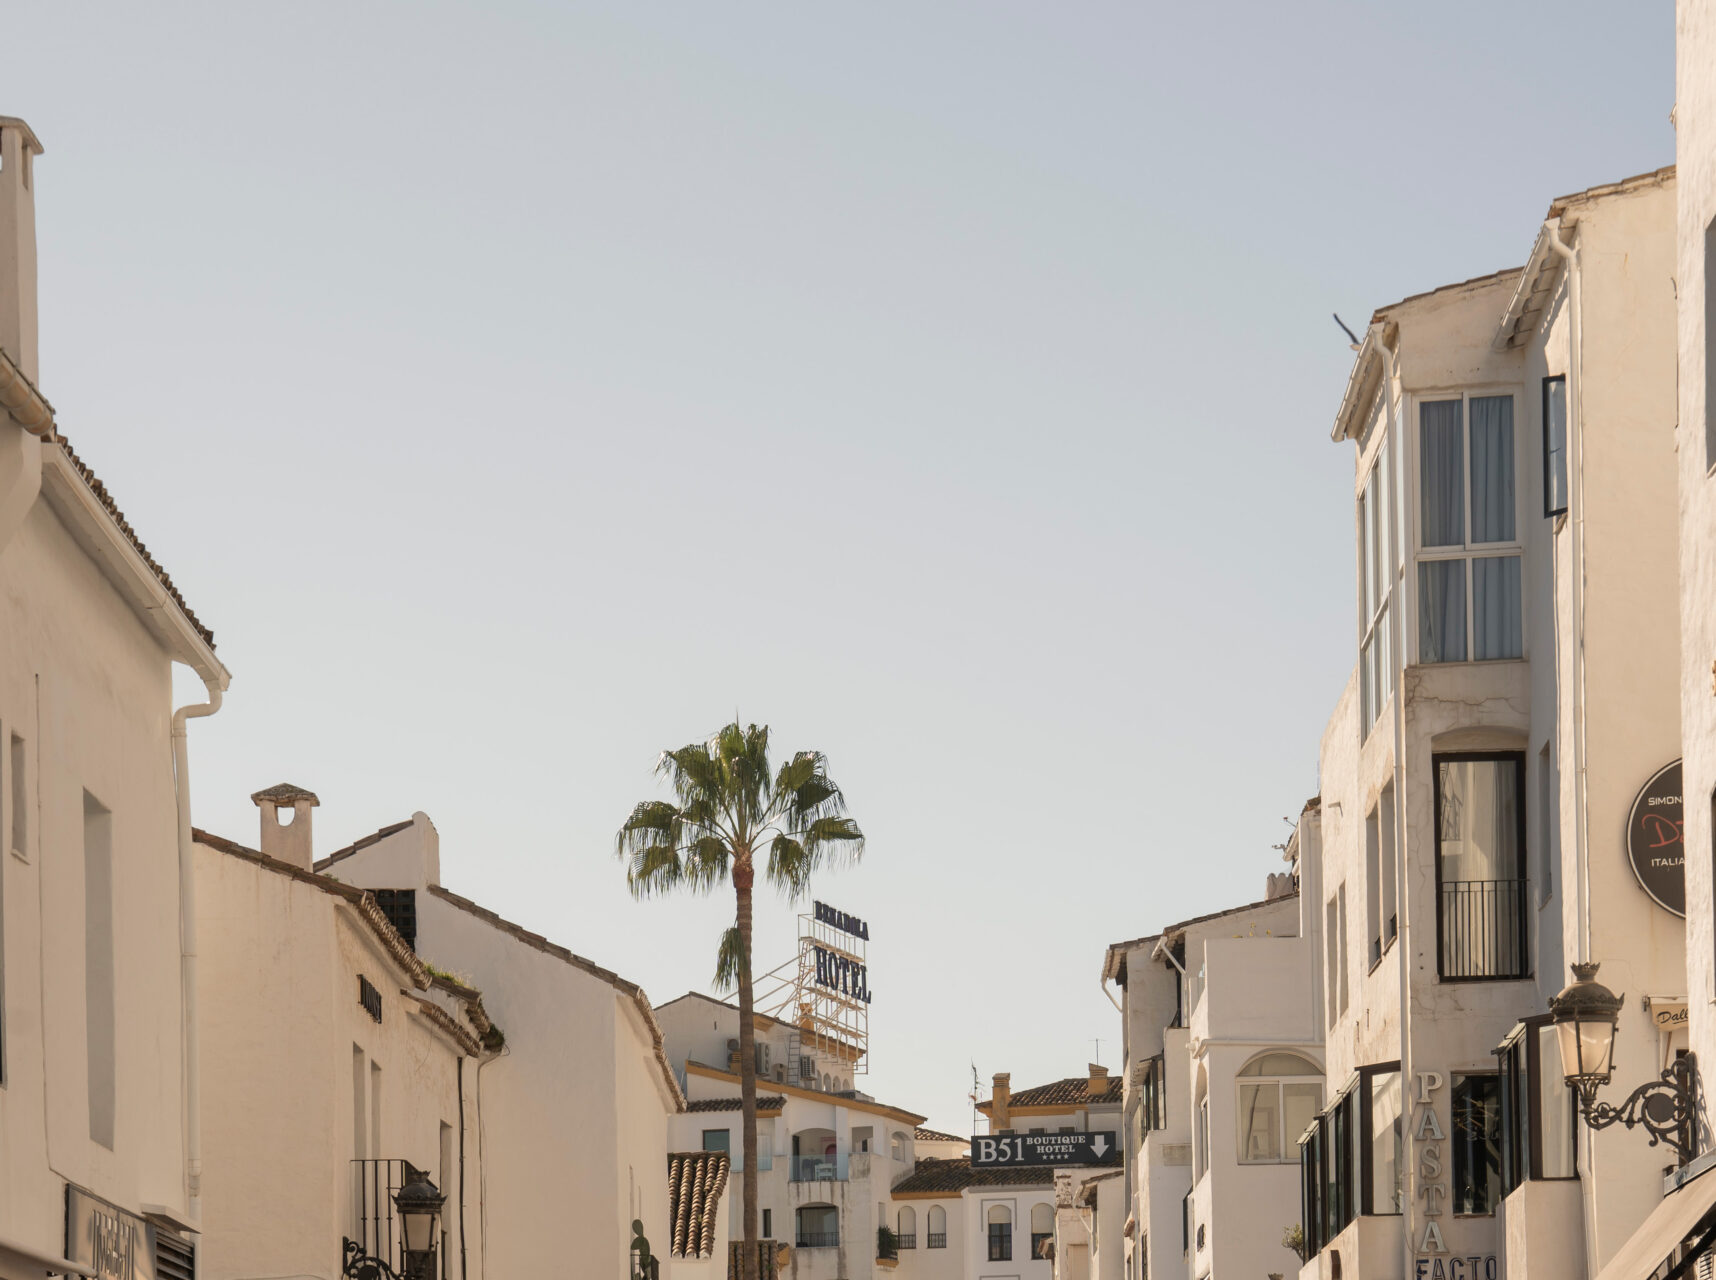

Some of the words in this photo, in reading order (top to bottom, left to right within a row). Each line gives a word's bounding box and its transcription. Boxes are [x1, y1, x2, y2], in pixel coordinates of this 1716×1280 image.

[814, 945, 871, 1004] HOTEL
[977, 1137, 1025, 1163] B51
[1026, 1135, 1086, 1145] BOUTIQUE
[1036, 1145, 1076, 1154] HOTEL
[1415, 1071, 1449, 1253] PASTA
